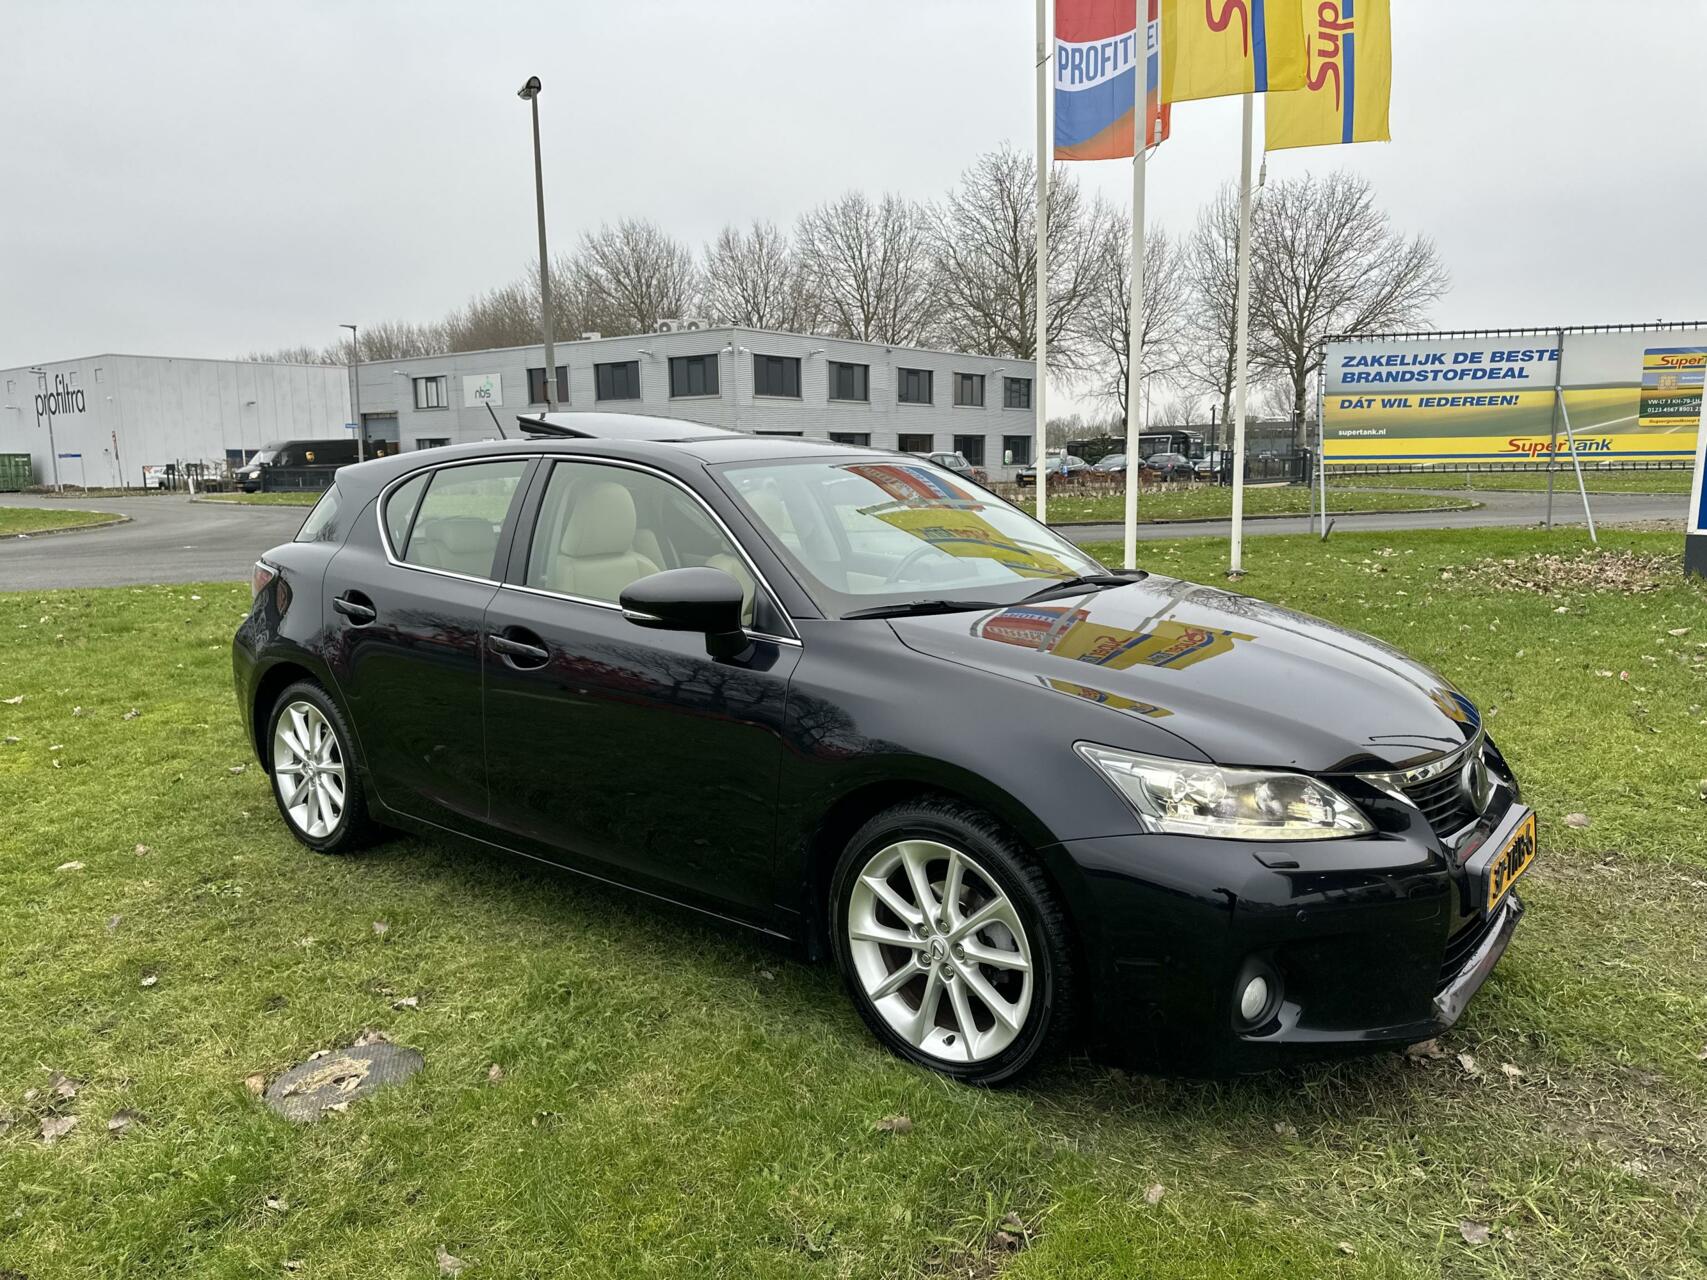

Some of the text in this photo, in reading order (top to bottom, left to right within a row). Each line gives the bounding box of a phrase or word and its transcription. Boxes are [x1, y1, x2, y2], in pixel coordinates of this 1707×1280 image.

[1341, 349, 1560, 367] ZAKELIJK DE BESTE
[1341, 367, 1529, 384] BRANDSTOFDEAL
[35, 373, 86, 427] profiltra
[1339, 395, 1519, 410] DÁT WIL IEDEREEN!
[1338, 428, 1387, 436] supertank.nl
[1498, 438, 1612, 458] SuperTank
